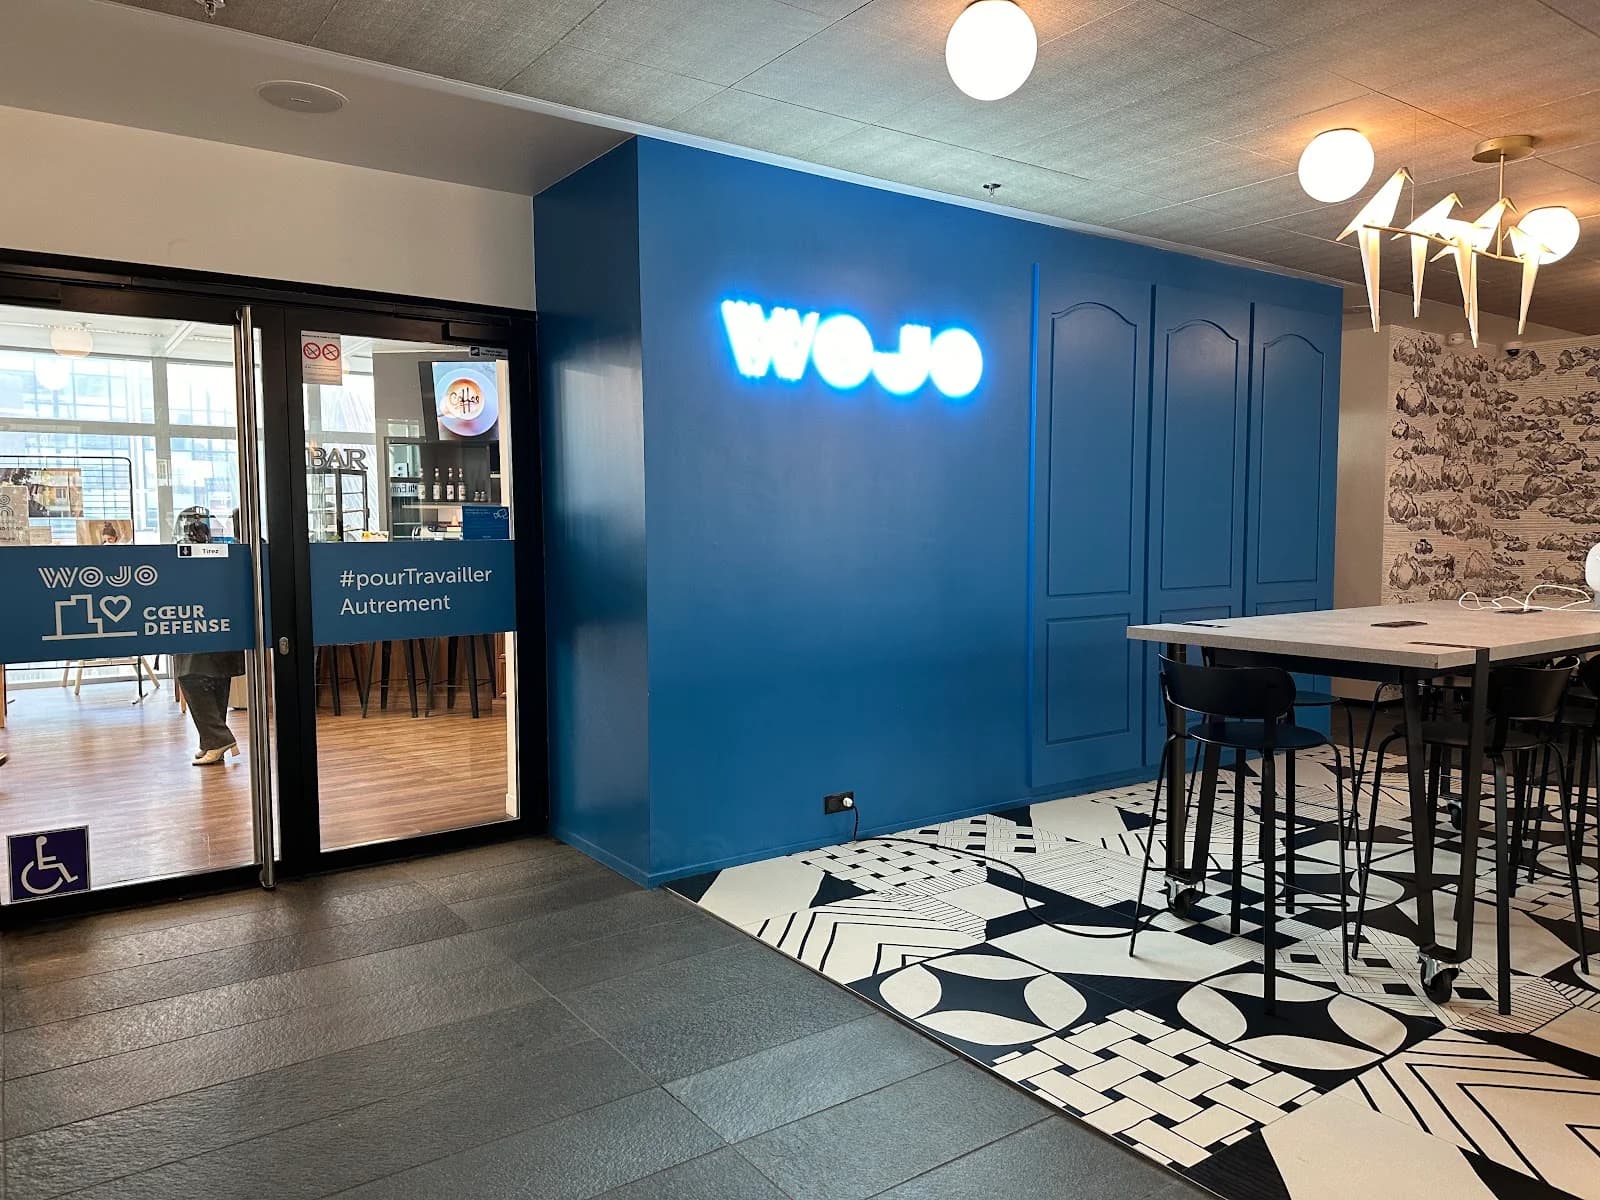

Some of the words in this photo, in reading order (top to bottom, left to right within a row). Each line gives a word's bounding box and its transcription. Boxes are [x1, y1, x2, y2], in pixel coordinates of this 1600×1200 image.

[721, 299, 983, 398] WOJO
[304, 447, 368, 470] BAR
[202, 547, 220, 555] Tirez
[38, 565, 158, 589] WOJO
[339, 566, 492, 591] #pourTravailler
[143, 605, 205, 621] CŒUR
[340, 595, 451, 616] Autrement
[144, 618, 231, 636] DEFENSE
